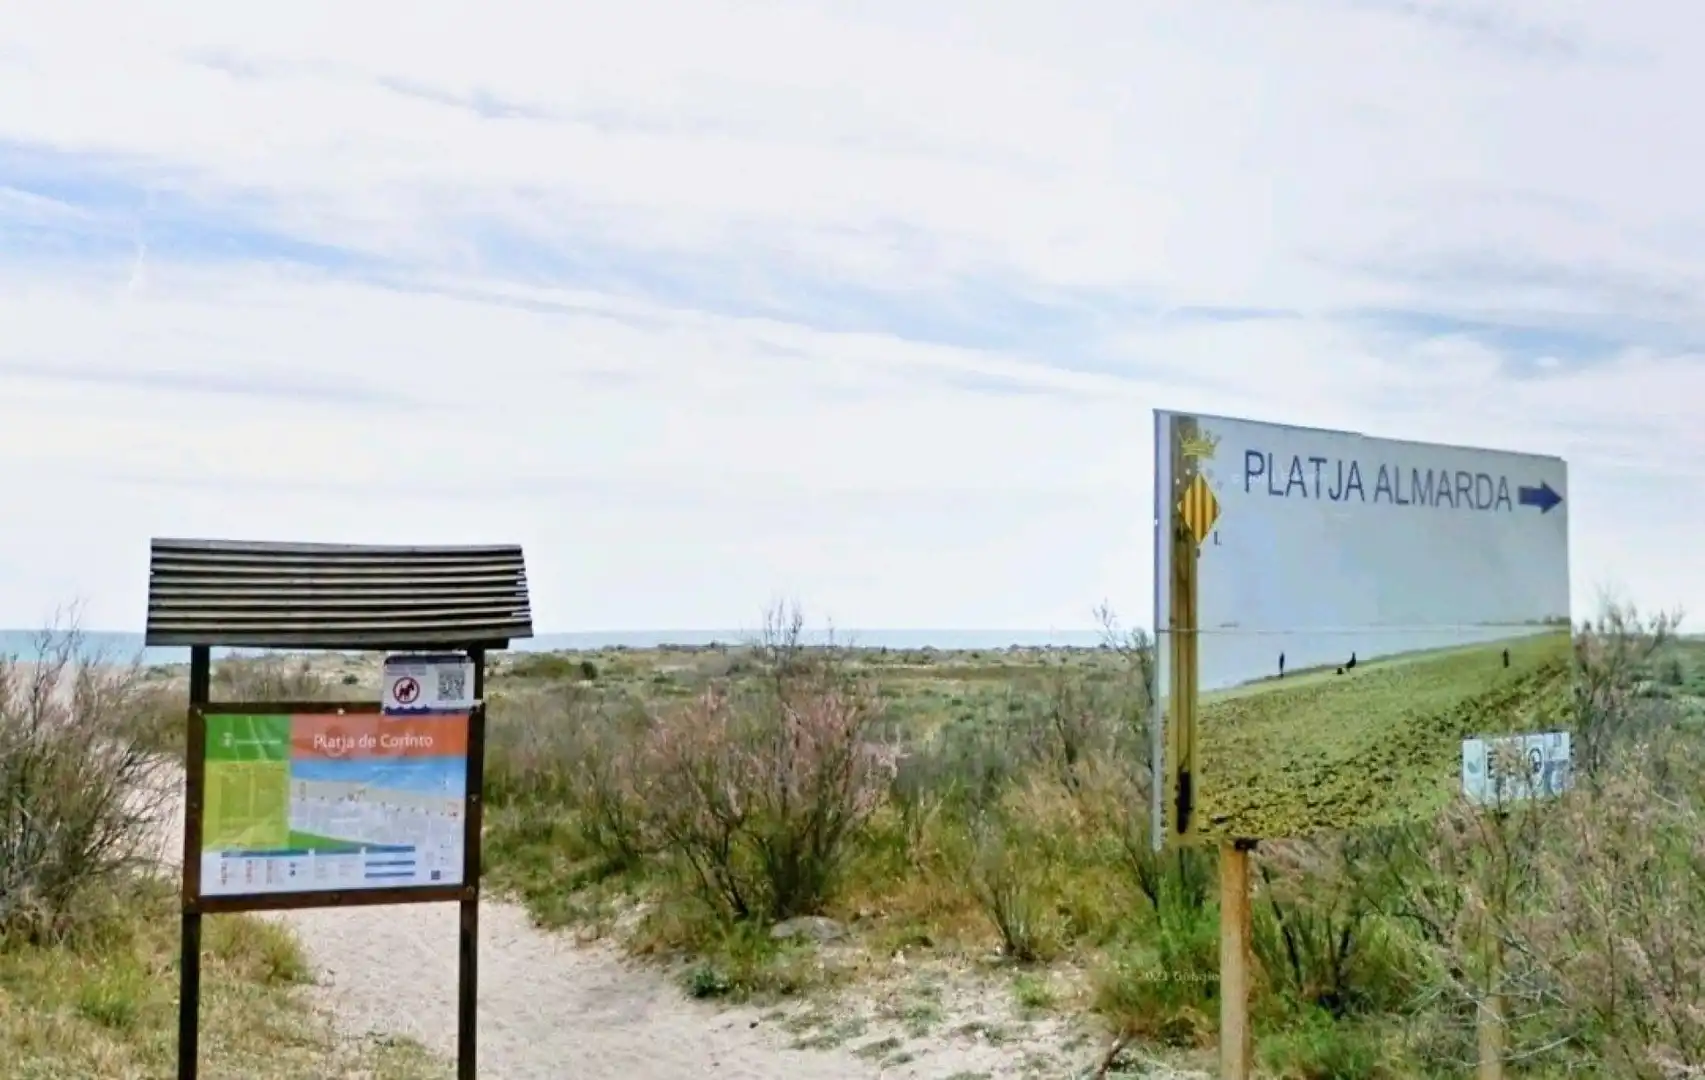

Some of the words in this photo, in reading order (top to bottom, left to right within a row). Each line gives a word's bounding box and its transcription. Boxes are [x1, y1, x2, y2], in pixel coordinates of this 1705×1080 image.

[1244, 449, 1365, 502] PLATJA
[1374, 463, 1513, 512] ALMARDA
[313, 733, 355, 752] Platja
[358, 732, 376, 748] de
[380, 732, 434, 748] Corinto
